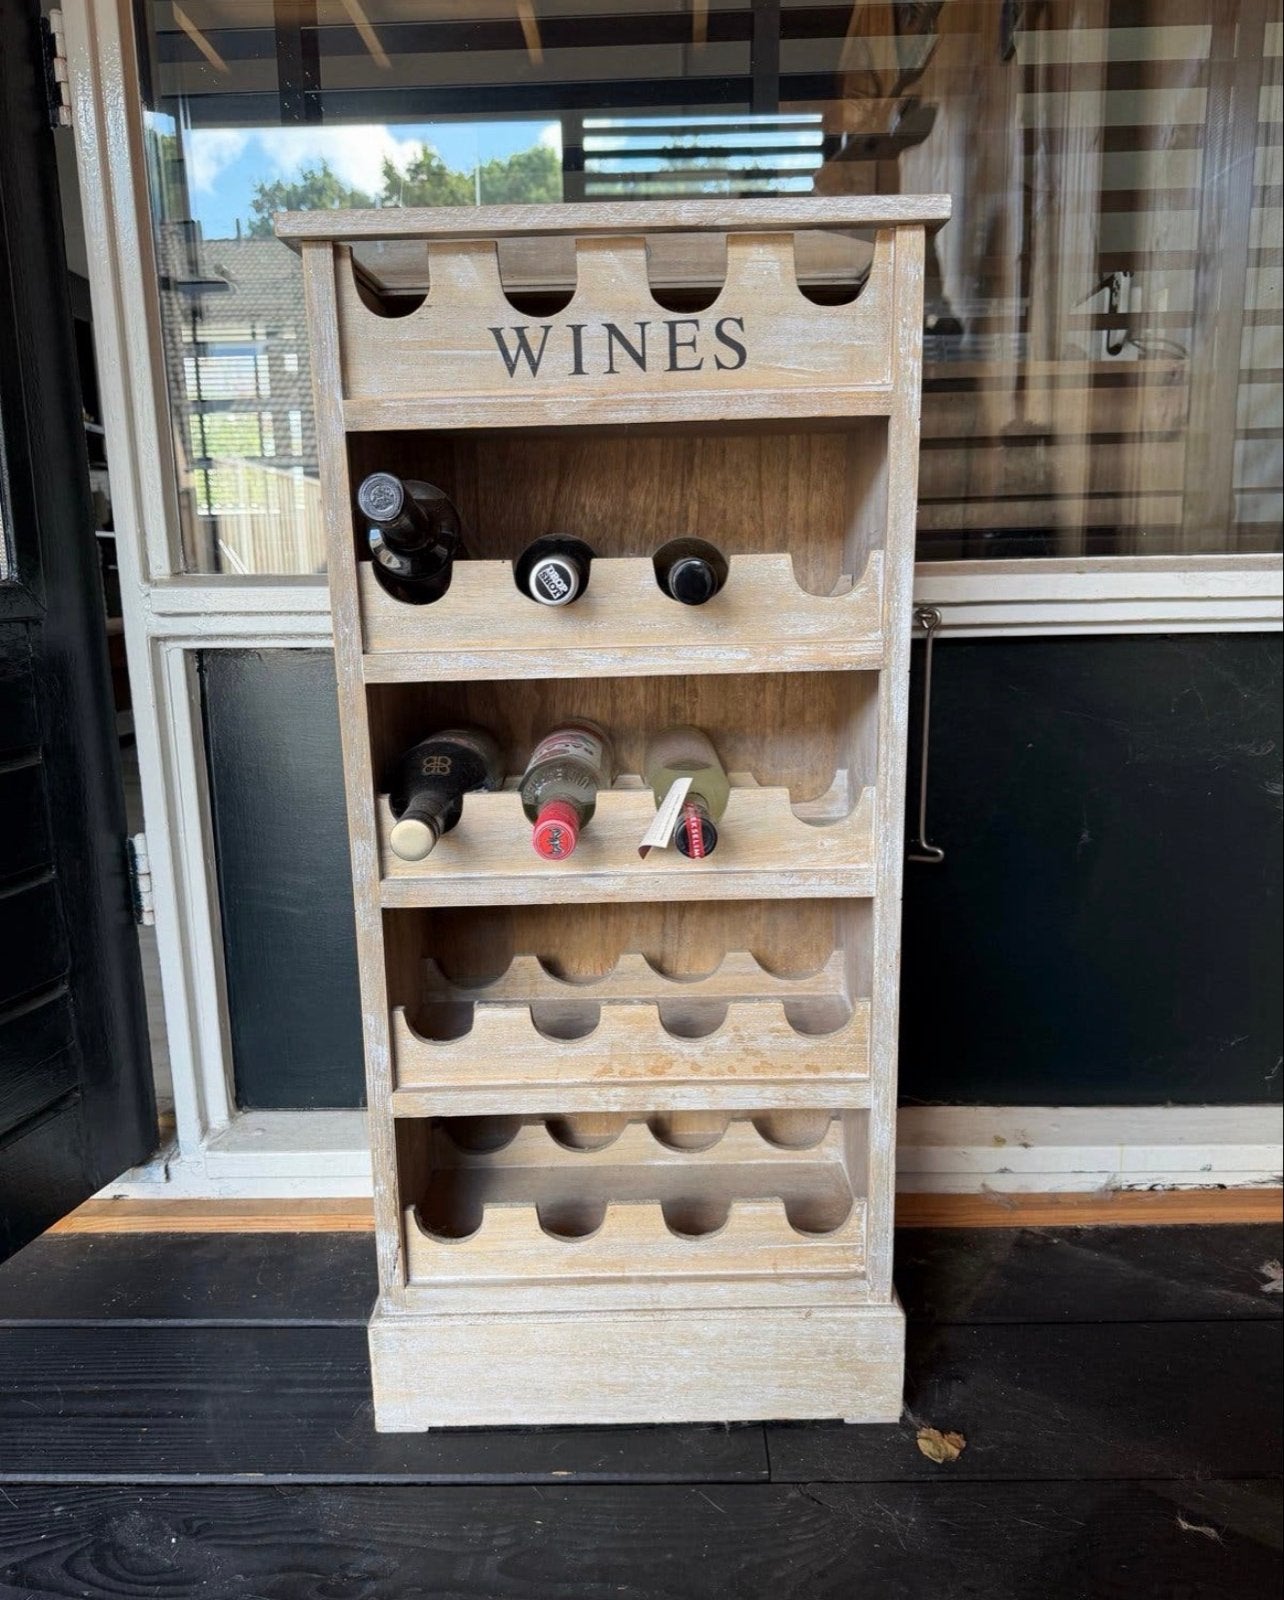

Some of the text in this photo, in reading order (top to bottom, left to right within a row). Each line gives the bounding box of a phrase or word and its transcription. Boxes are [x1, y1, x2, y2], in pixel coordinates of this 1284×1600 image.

[488, 317, 748, 378] WINES
[540, 571, 562, 597] SHOT
[547, 564, 569, 592] DROP
